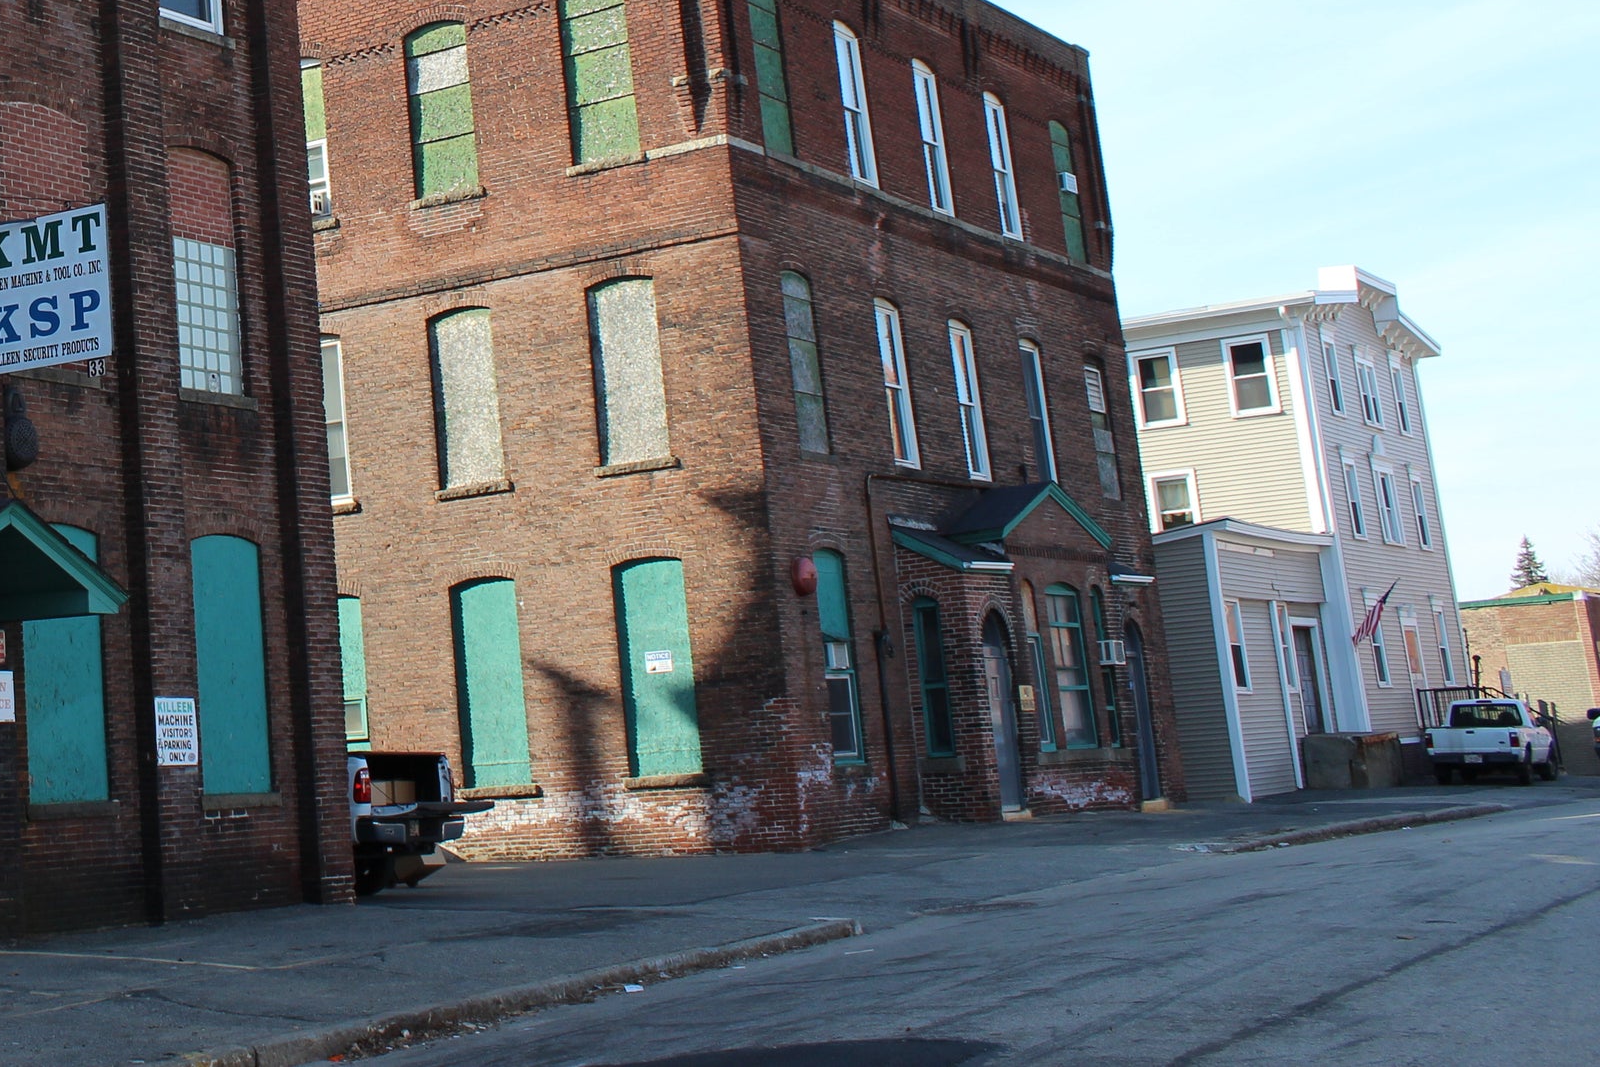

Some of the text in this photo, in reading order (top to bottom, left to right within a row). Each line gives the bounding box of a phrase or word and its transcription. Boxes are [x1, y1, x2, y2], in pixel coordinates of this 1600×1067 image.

[11, 271, 43, 288] MACHINE
[46, 270, 51, 282] &
[53, 265, 71, 281] TOOL
[88, 260, 103, 275] INC.
[24, 344, 59, 363] SECURITY
[61, 337, 100, 356] PRODUCTS
[90, 360, 105, 377] 33
[646, 652, 669, 660] NOTICE
[157, 702, 193, 713] KILLEEN
[158, 715, 193, 726] MACHINE
[162, 728, 193, 738] VISITORS
[164, 740, 192, 750] PARKING
[169, 752, 187, 762] ONLY
